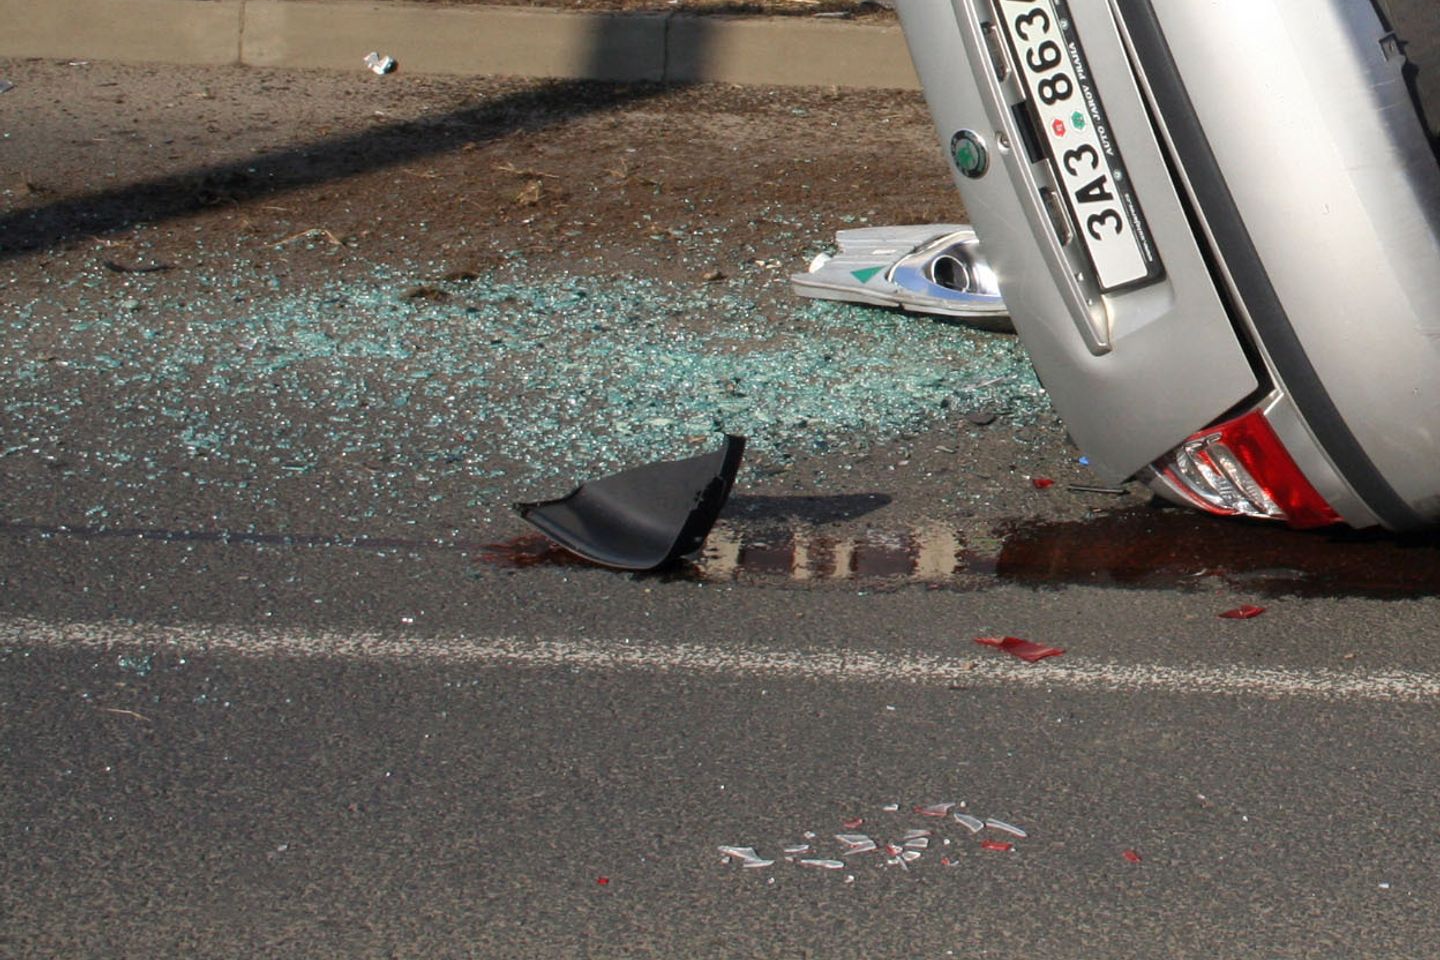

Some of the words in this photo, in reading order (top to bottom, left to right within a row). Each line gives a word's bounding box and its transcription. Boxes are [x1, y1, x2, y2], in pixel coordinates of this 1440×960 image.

[1068, 42, 1087, 81] PRAHA
[1082, 84, 1101, 121] JAROV
[1097, 125, 1114, 156] AUTO
[1063, 144, 1123, 241] 3A3
